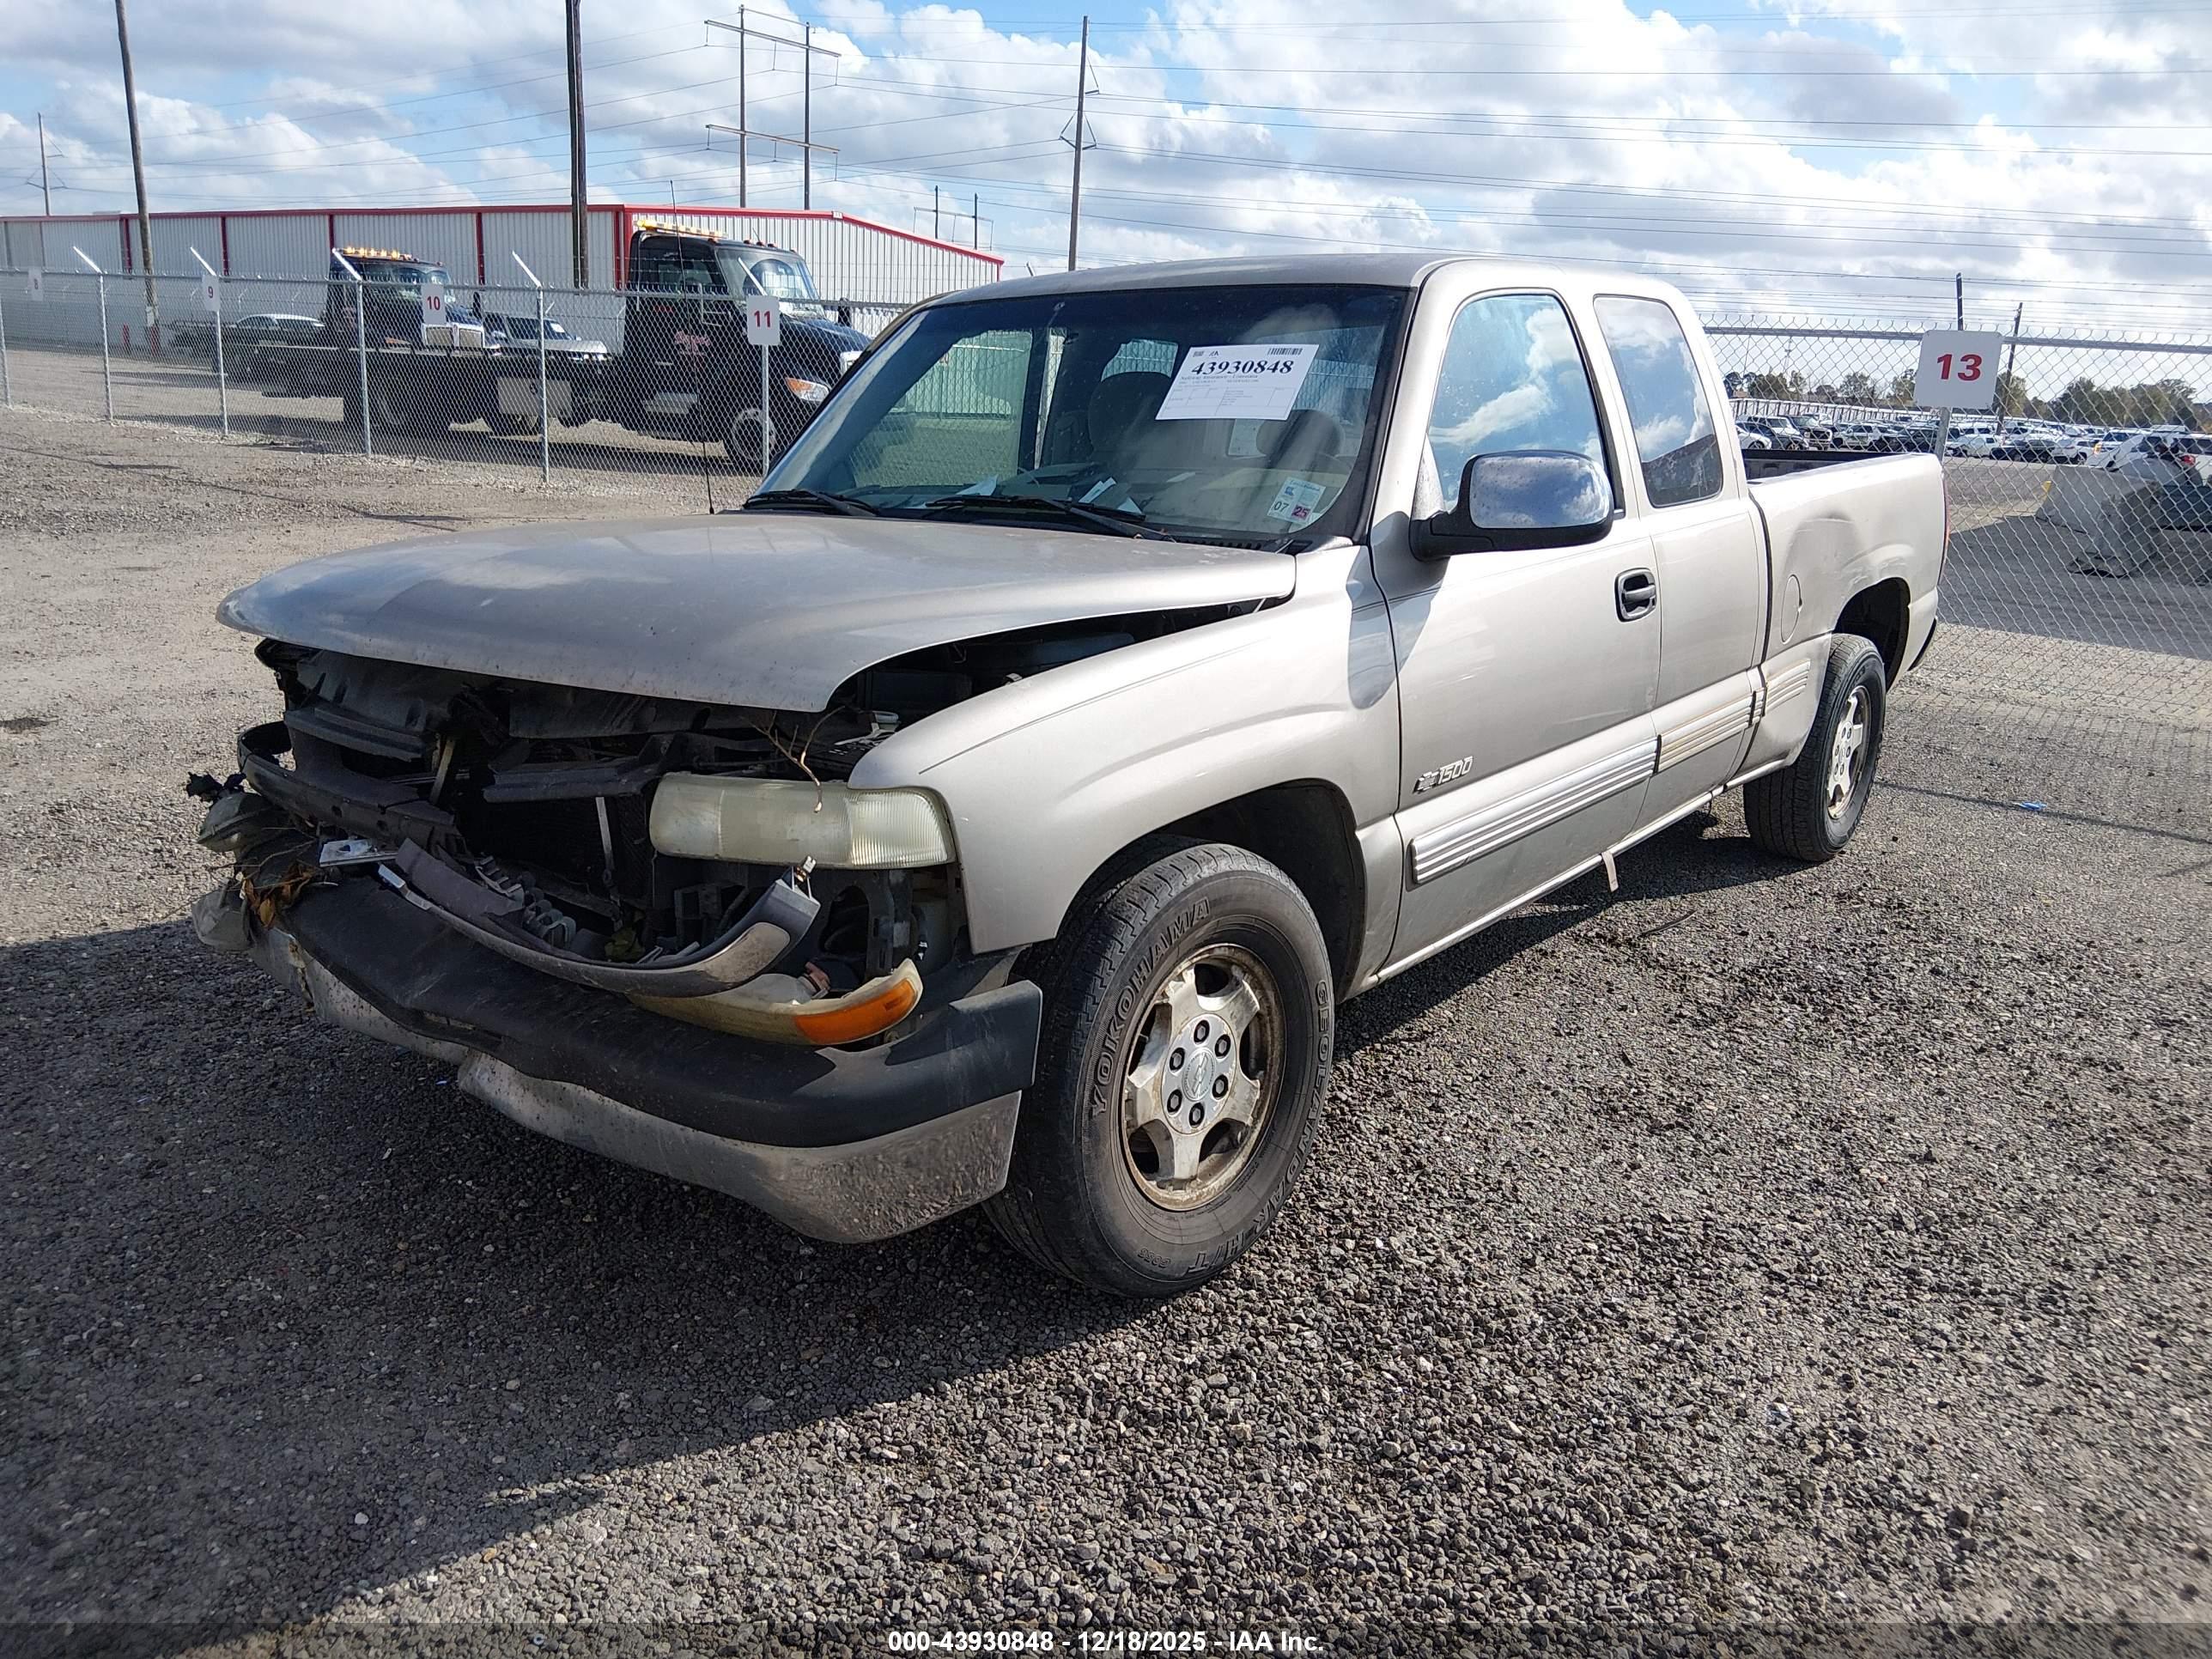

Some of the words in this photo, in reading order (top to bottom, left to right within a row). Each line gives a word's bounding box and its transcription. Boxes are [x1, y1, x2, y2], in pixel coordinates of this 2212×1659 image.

[208, 286, 214, 298] 9
[427, 295, 441, 310] 10
[754, 310, 771, 327] 11
[1191, 360, 1294, 375] 43930848
[1937, 354, 1983, 380] 13
[1273, 501, 1290, 513] 07
[1291, 506, 1311, 518] 25
[1437, 756, 1474, 785] 1500
[1091, 896, 1211, 1116] YOKOHAMA
[1253, 979, 1332, 1234] GEOLANDAR
